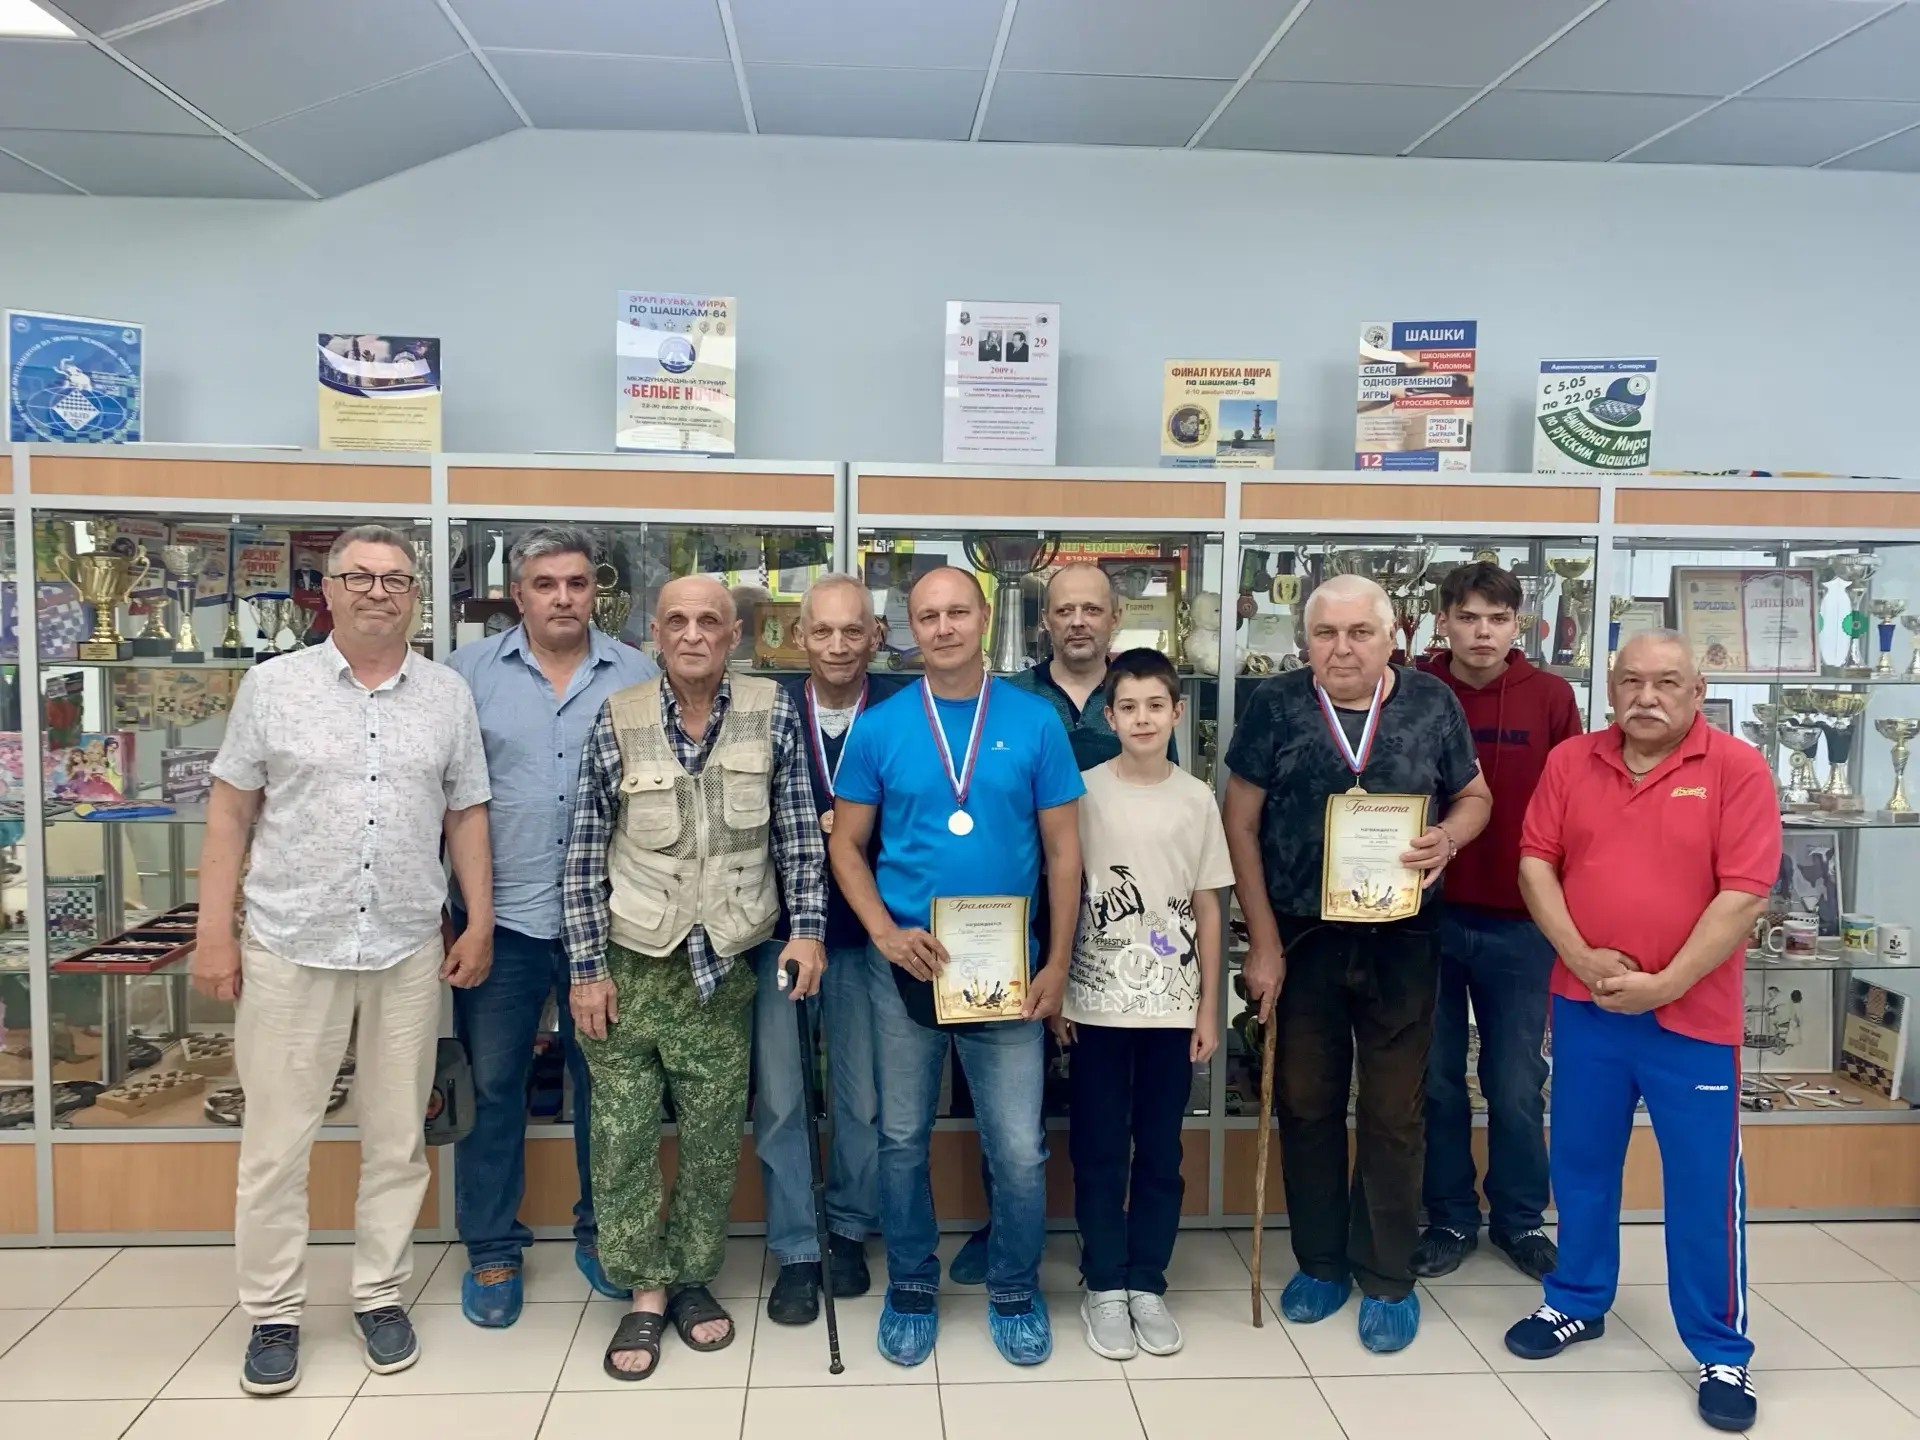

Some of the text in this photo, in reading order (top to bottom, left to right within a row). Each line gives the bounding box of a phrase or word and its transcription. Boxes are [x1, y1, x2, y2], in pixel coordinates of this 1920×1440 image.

[630, 295, 727, 309] ЭТАП КУБКА МИРА
[629, 304, 727, 319] ПО ШАШКАМ-64
[960, 336, 973, 346] 20
[1405, 328, 1465, 342] ШАШКИ
[1034, 338, 1047, 348] 29
[990, 366, 1009, 374] 2009
[1363, 365, 1395, 374] СЕАНС
[1432, 362, 1471, 370] Коломны
[1551, 363, 1605, 371] Администрация
[1617, 363, 1647, 371] Самары
[1171, 367, 1272, 378] ФИНАЛ КУБКА МИРА
[626, 376, 727, 387] МЕЖДУНАРОДНЫЙ ТУРНИР
[1363, 376, 1452, 387] ОДНОВРЕМЕННОЙ
[1557, 376, 1587, 392] 5.05
[623, 384, 681, 400] «БЕЛЫЕ
[1362, 391, 1389, 399] ИГРЫ
[1401, 399, 1470, 407] ГРОССМЕЙСТЕРАМИ
[1542, 387, 1601, 411] по 22.05
[1544, 415, 1558, 427] по
[1596, 453, 1647, 467] шашкам
[1612, 435, 1648, 454] Мира
[1361, 454, 1383, 467] 12
[1345, 799, 1410, 815] Грамота
[948, 899, 1012, 912] Грамота
[1088, 880, 1145, 930] FUN
[1095, 938, 1132, 946] FREESTYLE
